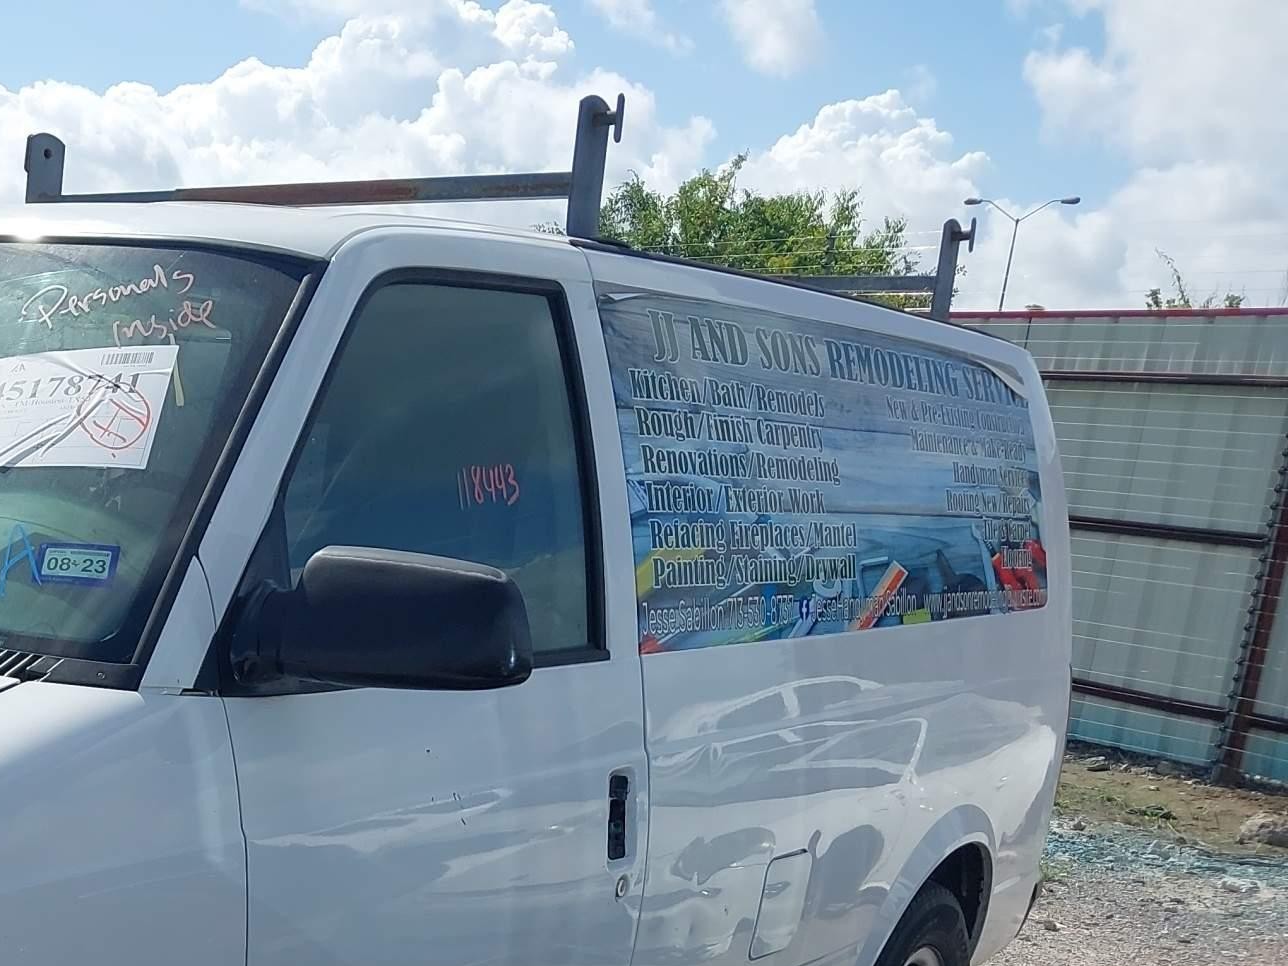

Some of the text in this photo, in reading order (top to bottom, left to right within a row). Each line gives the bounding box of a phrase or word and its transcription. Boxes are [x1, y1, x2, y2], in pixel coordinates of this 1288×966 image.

[647, 308, 1030, 409] JJ AND SONS REMODELING SERVI
[628, 368, 825, 418] Kitchen/Bath/Remodels
[634, 405, 824, 452] Rough/Finish Carpentry
[640, 443, 841, 487] Renovations/Remodeling
[457, 463, 520, 511] 118443
[645, 480, 827, 514] Interior/Exterior Work
[945, 488, 980, 516] Roofing
[648, 518, 857, 552] Refacing Fireplaces/Mantel
[651, 553, 857, 590] Painting/Staining/Drywall
[642, 602, 675, 636] Jesse
[678, 596, 725, 633] Sabillon
